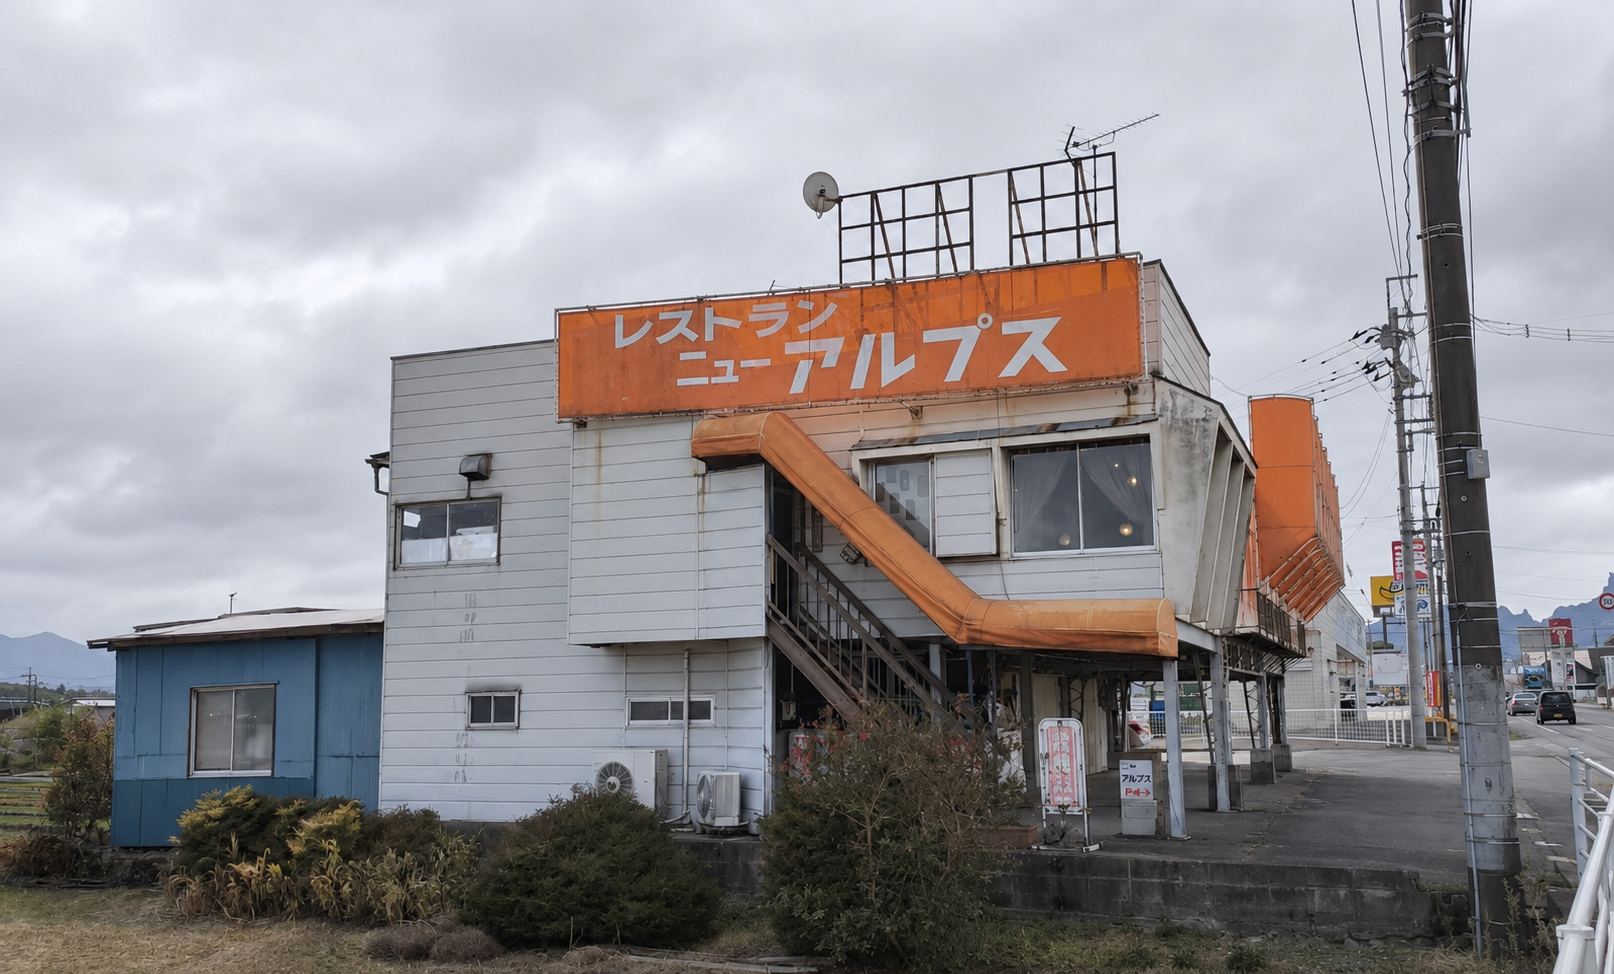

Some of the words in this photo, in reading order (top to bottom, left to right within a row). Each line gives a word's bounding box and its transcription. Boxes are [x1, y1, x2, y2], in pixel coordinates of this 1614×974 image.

[614, 300, 838, 349] レストラン
